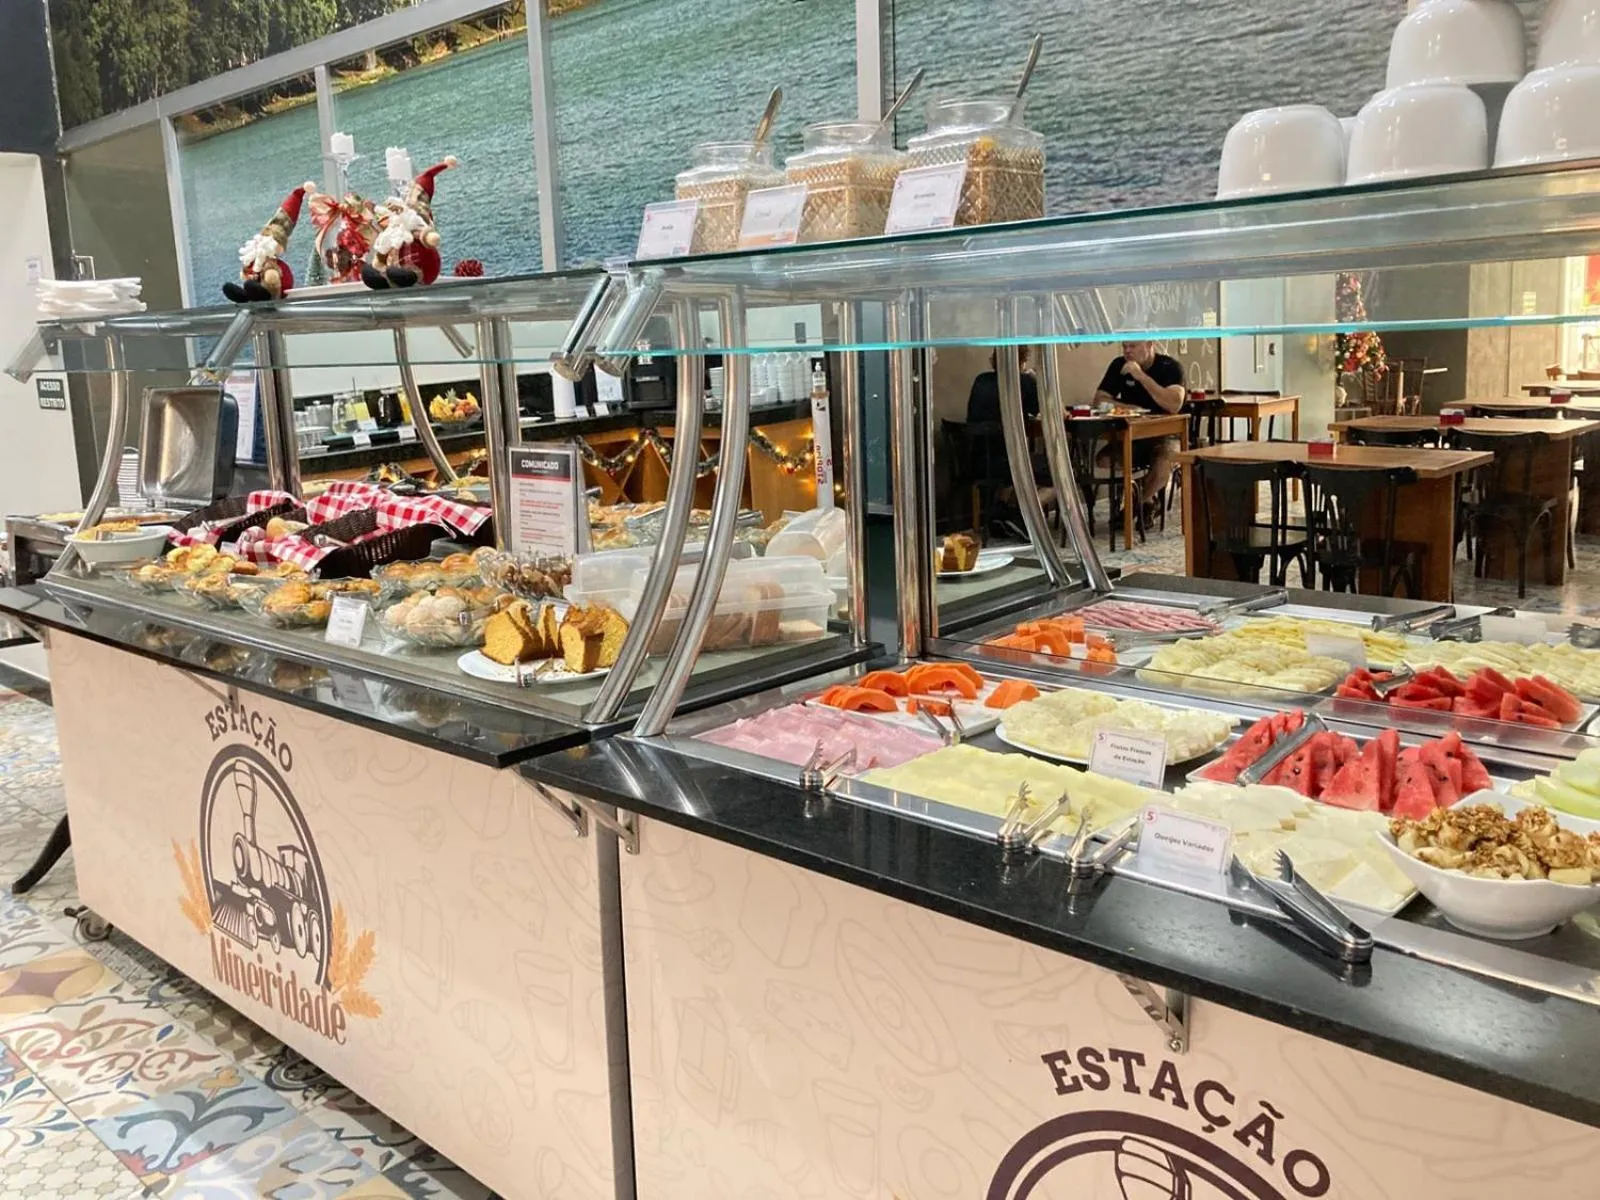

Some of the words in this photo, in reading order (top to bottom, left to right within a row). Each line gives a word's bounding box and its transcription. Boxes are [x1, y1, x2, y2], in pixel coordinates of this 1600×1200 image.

[520, 459, 559, 470] COMUNICADO
[205, 702, 293, 772] ESTAÇÃO
[1182, 839, 1216, 853] Variados
[210, 931, 347, 1046] Mineiridade
[1041, 1046, 1331, 1198] ESTAÇÃO
